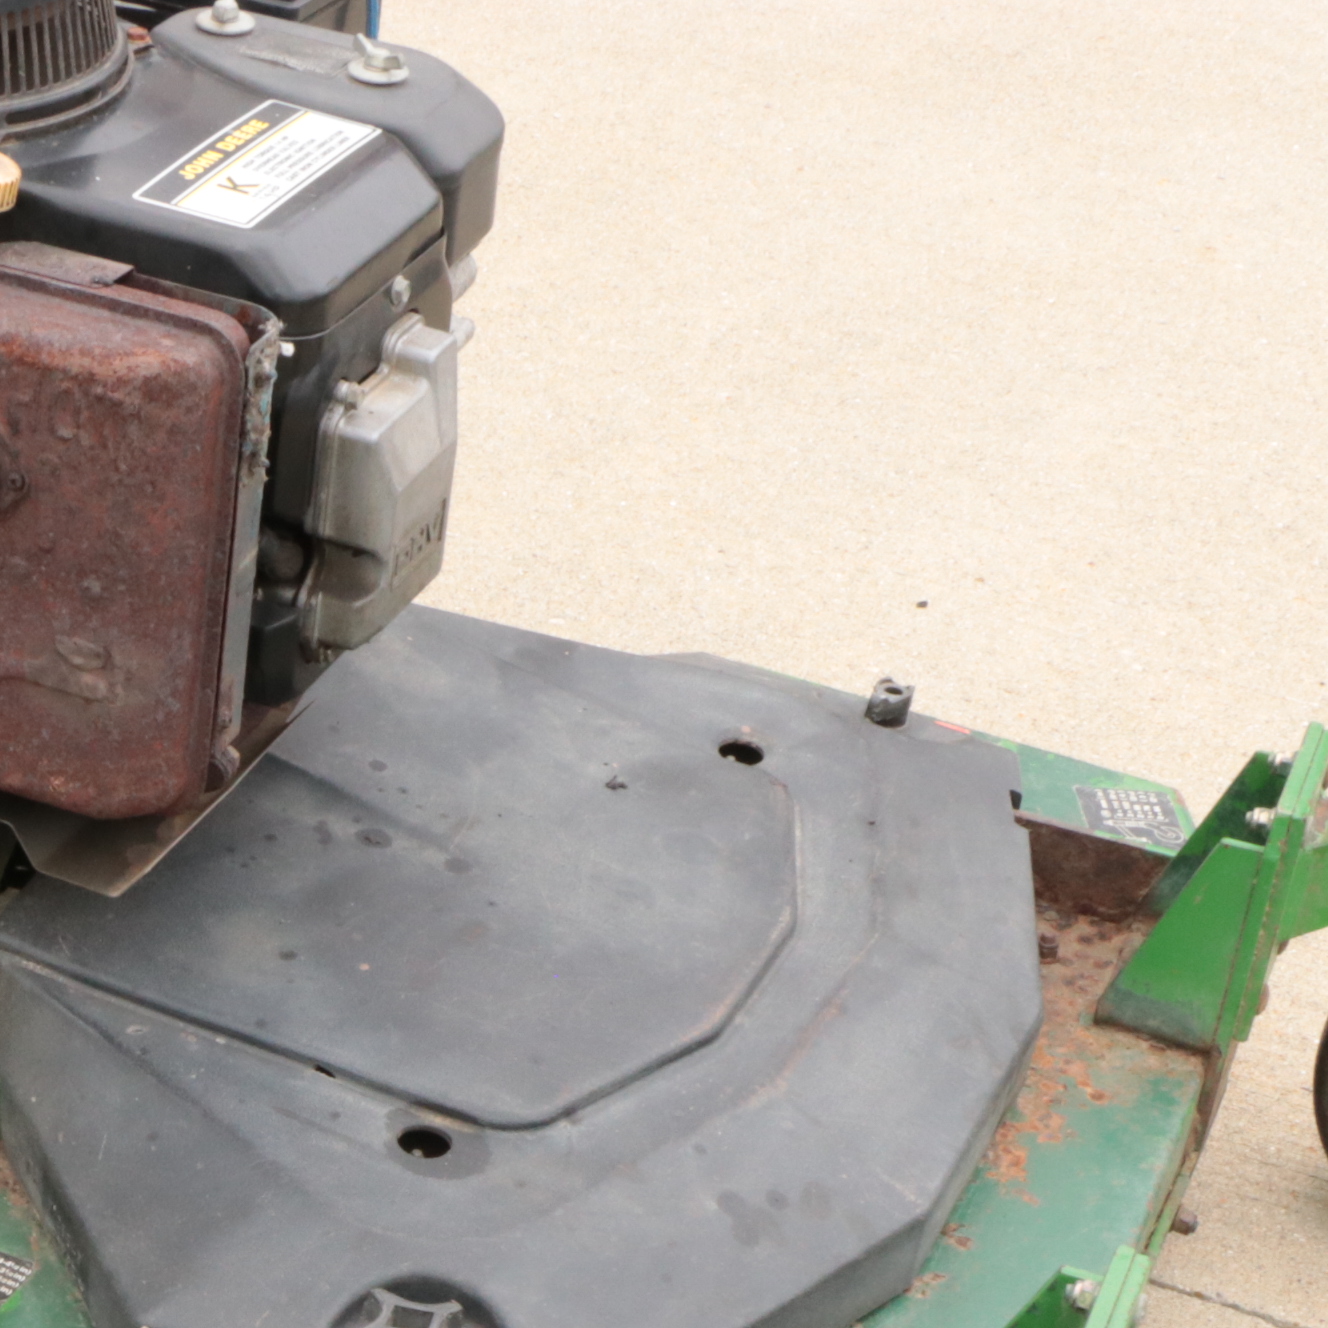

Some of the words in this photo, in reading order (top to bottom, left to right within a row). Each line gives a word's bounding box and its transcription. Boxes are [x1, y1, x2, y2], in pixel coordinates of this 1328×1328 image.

[179, 150, 223, 180] JOHN
[216, 118, 270, 151] DEERE
[217, 176, 258, 194] K
